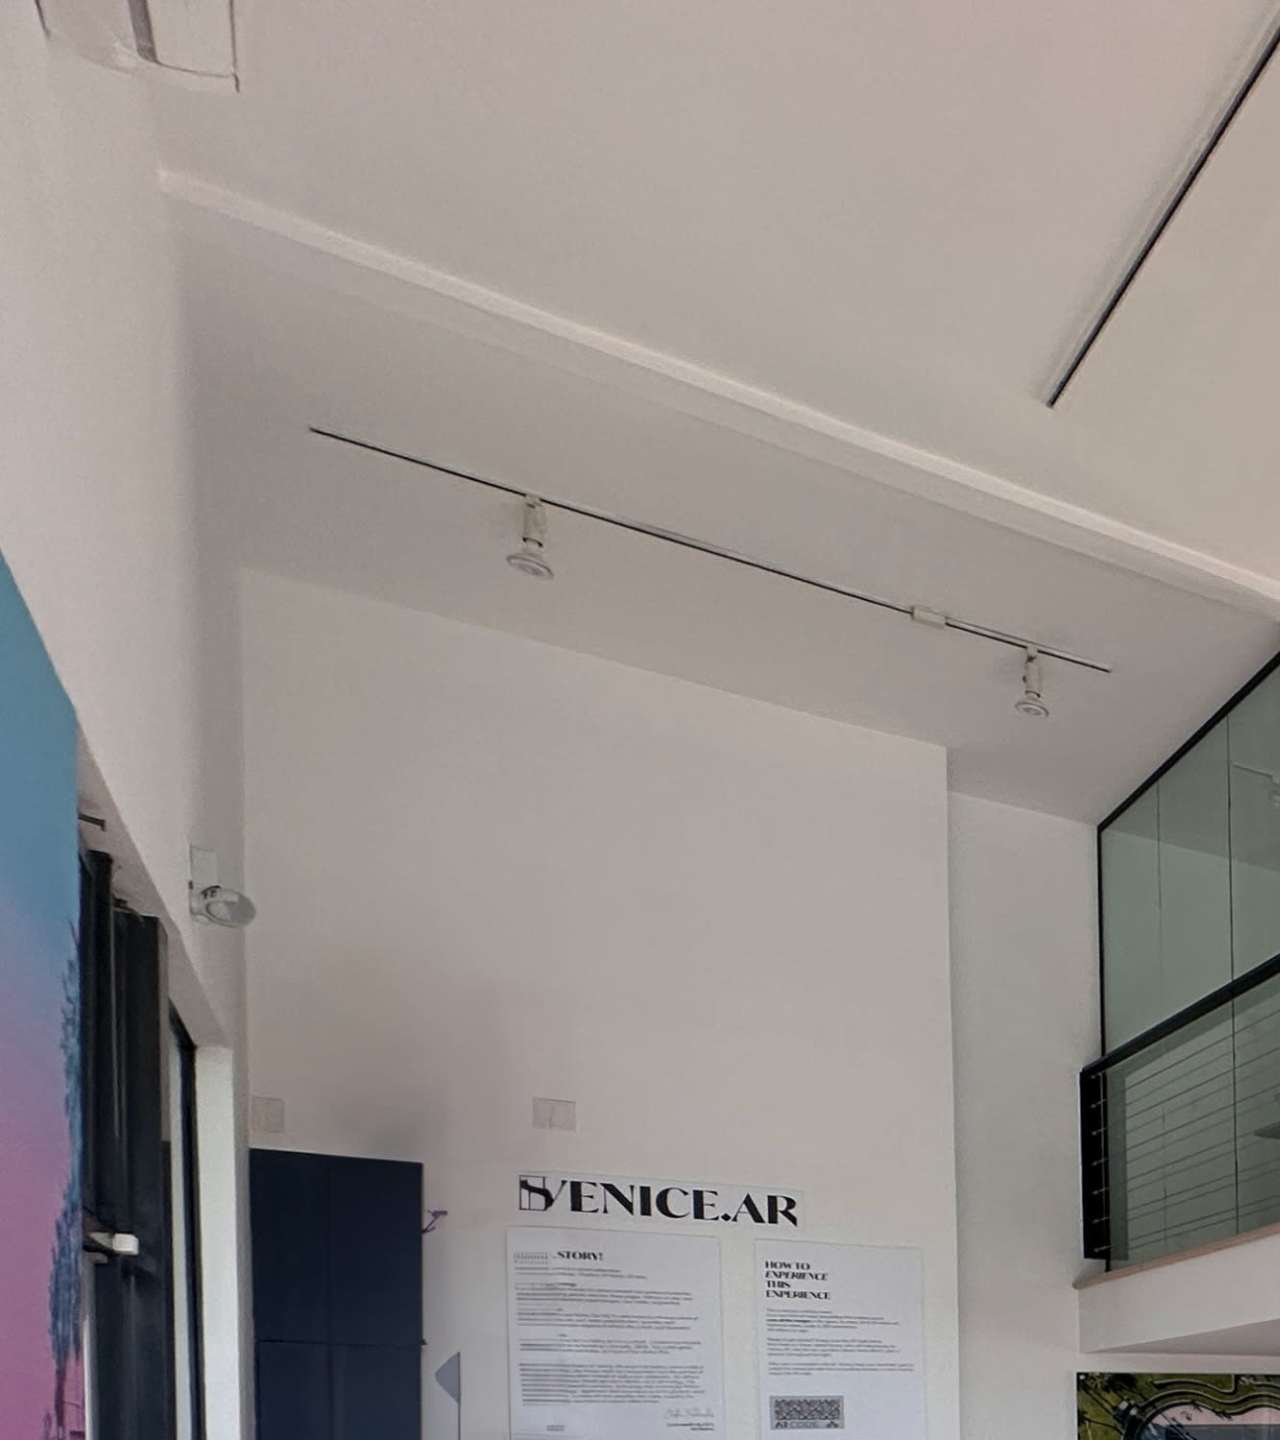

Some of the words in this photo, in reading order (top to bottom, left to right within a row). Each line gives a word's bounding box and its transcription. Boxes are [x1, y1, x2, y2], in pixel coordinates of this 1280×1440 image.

[764, 1260, 792, 1269] HOW
[795, 1261, 811, 1270] TO
[764, 1270, 829, 1281] EXPERIENCE
[766, 1280, 792, 1288] THIS
[765, 1289, 831, 1300] EXPERIENCE
